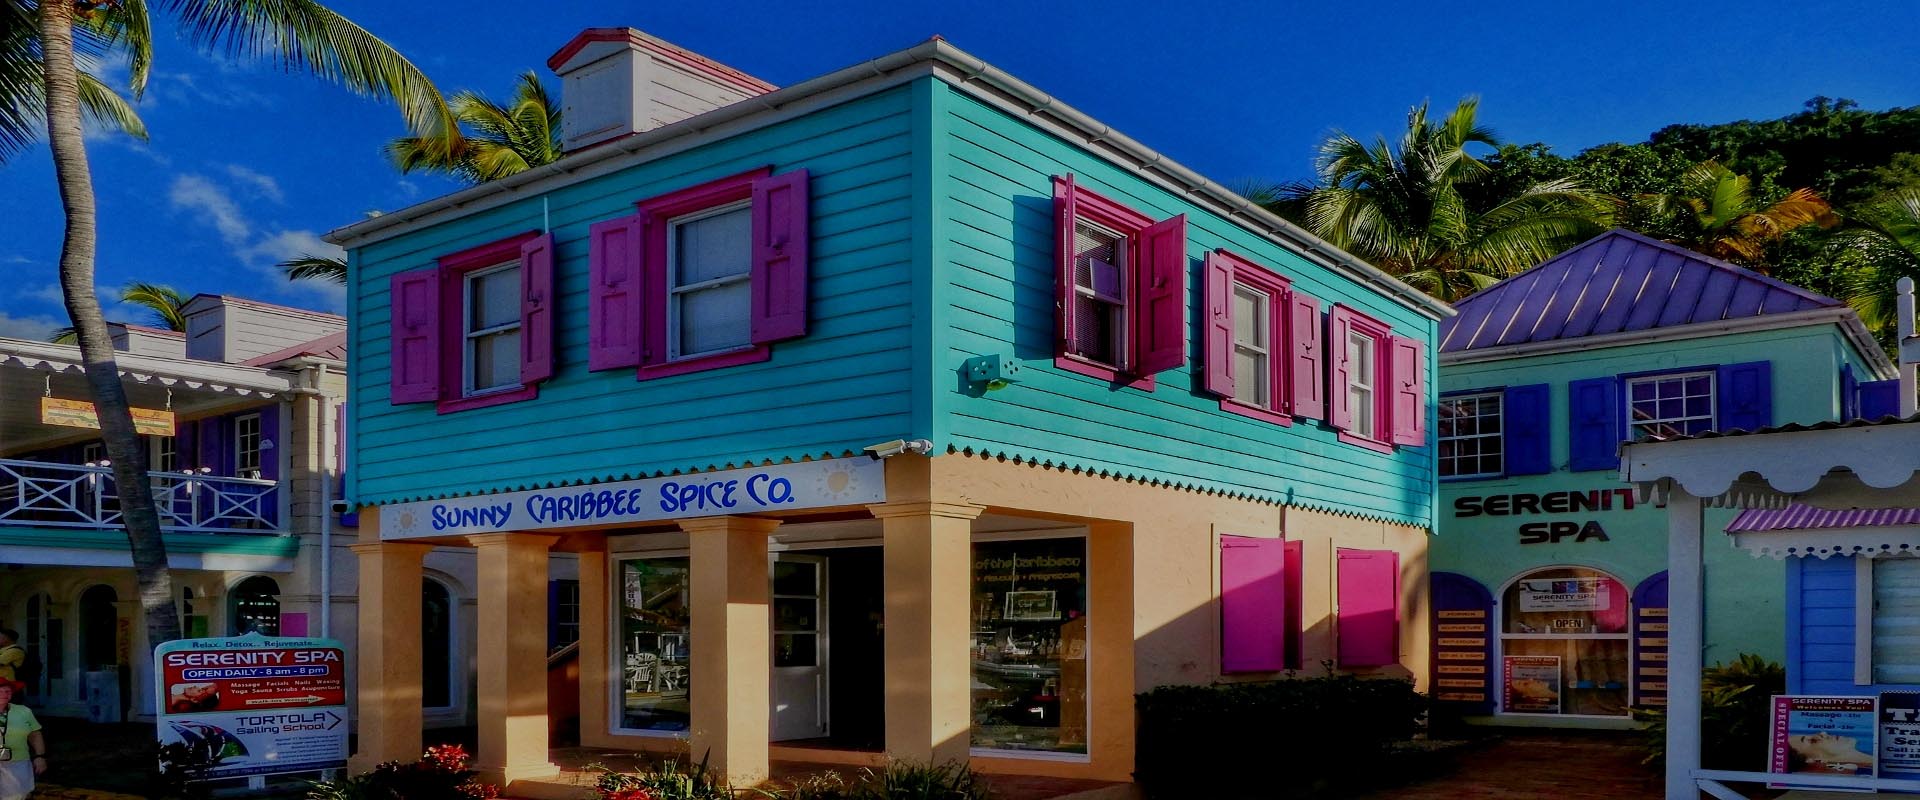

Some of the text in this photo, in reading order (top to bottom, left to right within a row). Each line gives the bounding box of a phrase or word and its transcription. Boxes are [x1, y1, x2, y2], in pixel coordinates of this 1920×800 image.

[432, 502, 512, 531] SUNNY
[526, 488, 642, 524] CARIBBEE
[660, 480, 738, 513] SPICE
[1454, 488, 1666, 518] SERENIT
[1519, 521, 1610, 545] SPA
[1556, 619, 1582, 628] OPEN
[167, 650, 339, 667] SERENITY SPA
[188, 669, 222, 678] OPEN
[224, 668, 258, 677] DAILY
[308, 667, 324, 675] pm
[236, 712, 325, 727] TORTOLA
[1801, 711, 1842, 719] Massage
[1886, 708, 1920, 722] T
[236, 722, 325, 735] Sailing School
[1775, 702, 1787, 773] SPECIAL OFFE
